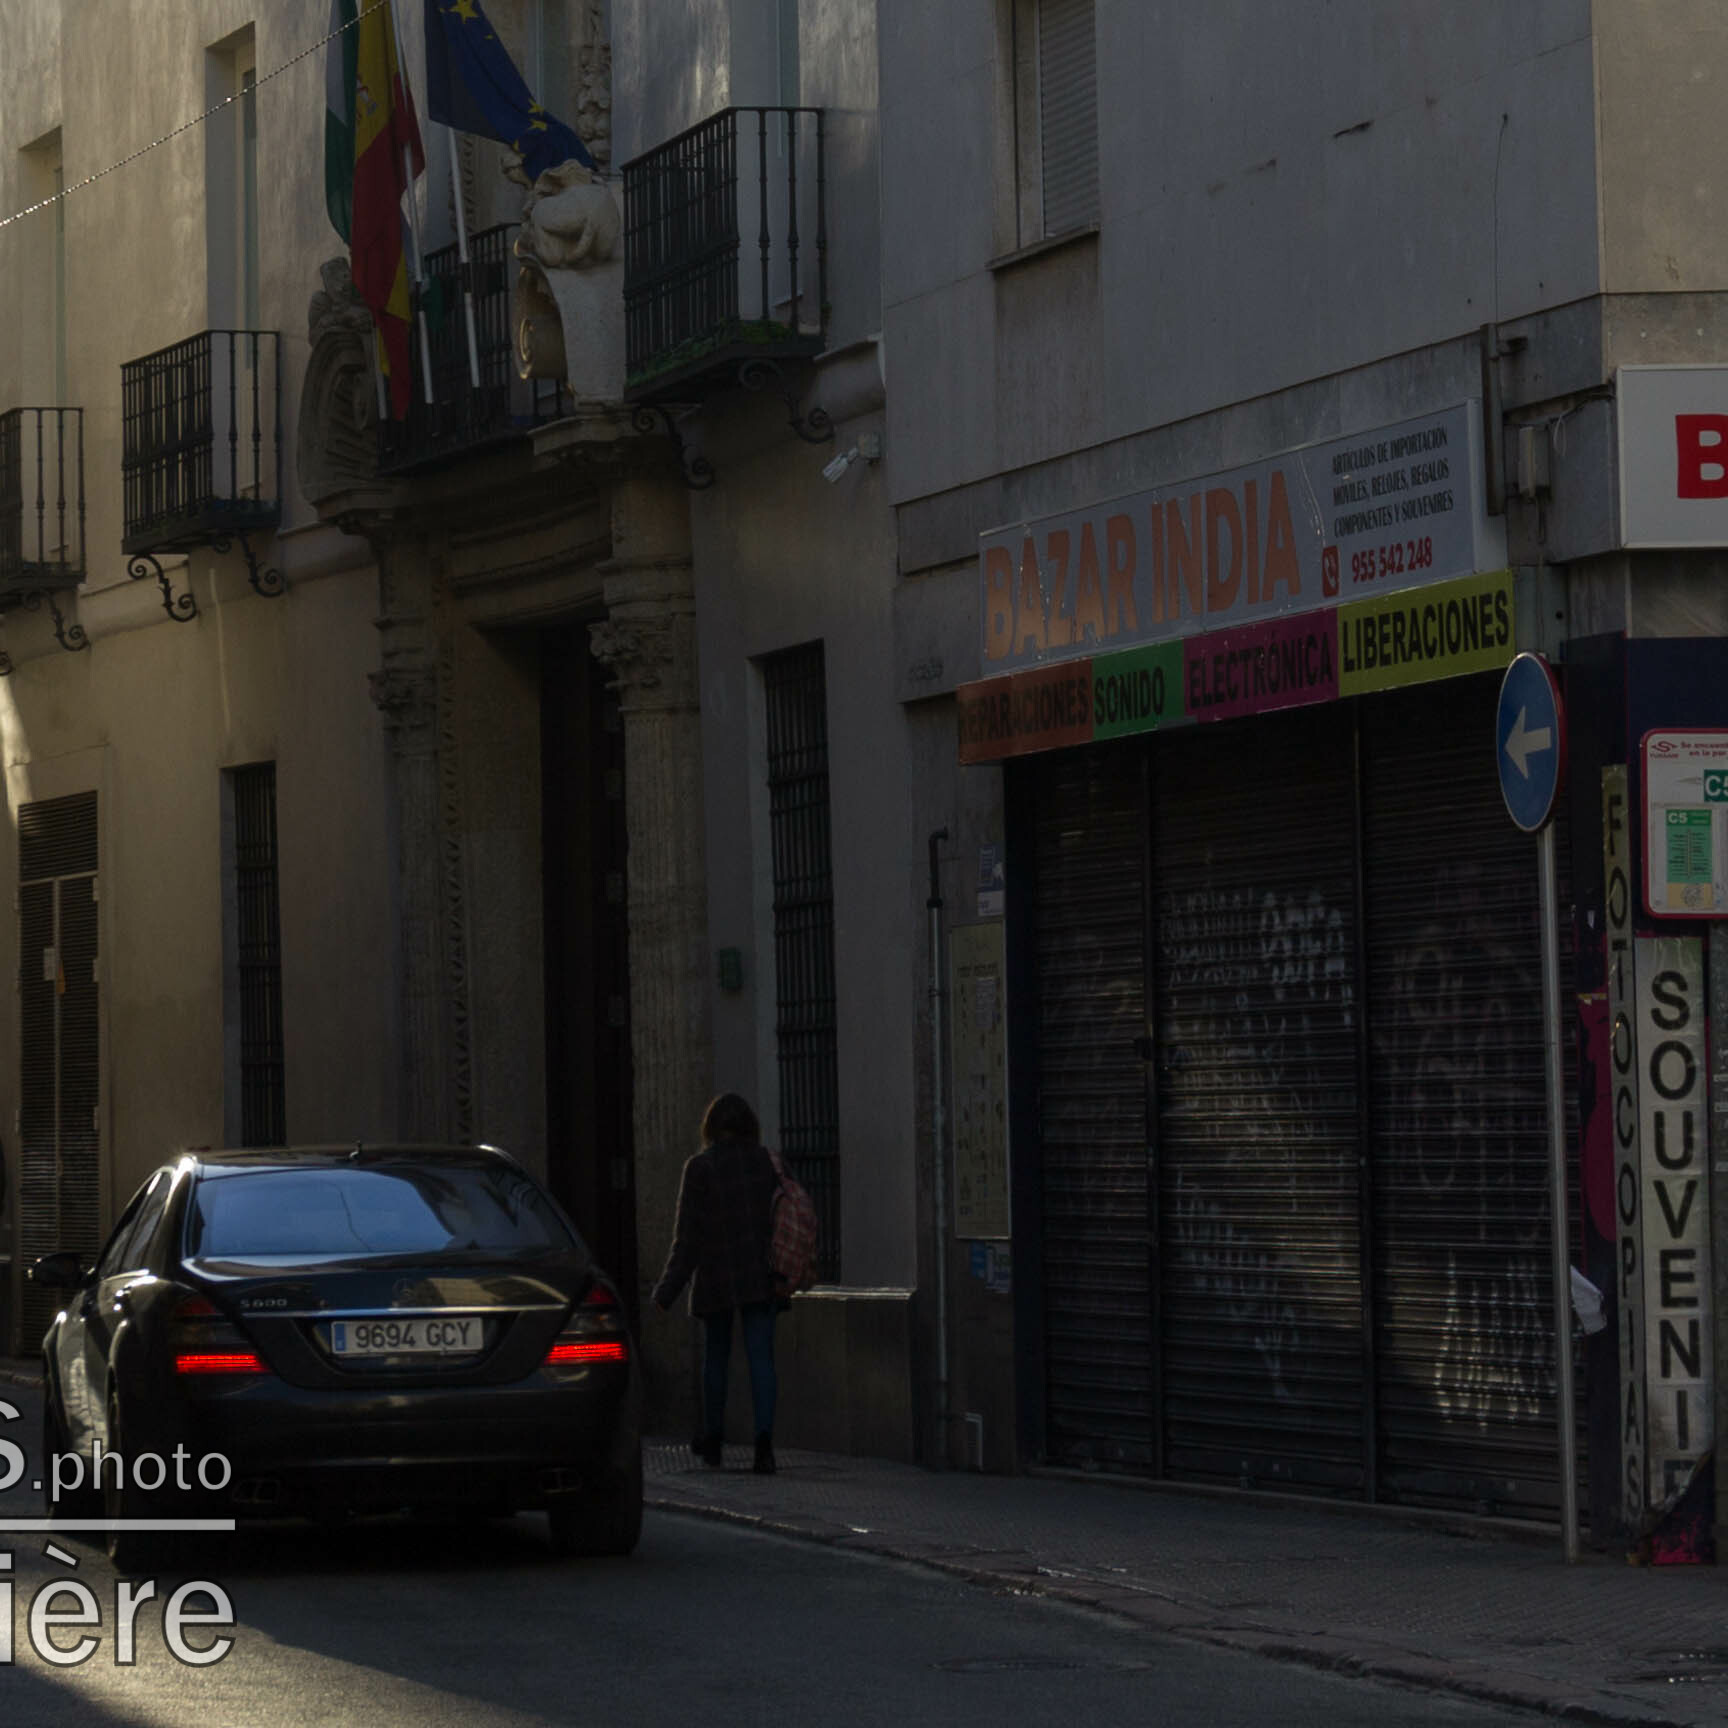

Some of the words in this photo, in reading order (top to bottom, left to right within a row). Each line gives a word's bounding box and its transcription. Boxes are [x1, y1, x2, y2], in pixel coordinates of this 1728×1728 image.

[1377, 443, 1389, 463] DE
[1411, 457, 1450, 487] REGALOS
[1334, 504, 1394, 538] COMPONENTES
[1401, 489, 1454, 521] SOUVENIRES
[985, 515, 1139, 660] BAZAR
[1151, 471, 1301, 623] INDIA
[1352, 549, 1377, 584] 955
[1379, 542, 1405, 577] 542
[1407, 536, 1433, 571] 248
[1342, 589, 1510, 670] LIBERACIONES
[1094, 667, 1165, 725] SONIDO
[1668, 812, 1689, 824] C5
[1606, 794, 1644, 1518] FOTOCOPIAS
[355, 1322, 416, 1349] 9694
[425, 1321, 471, 1346] GCY
